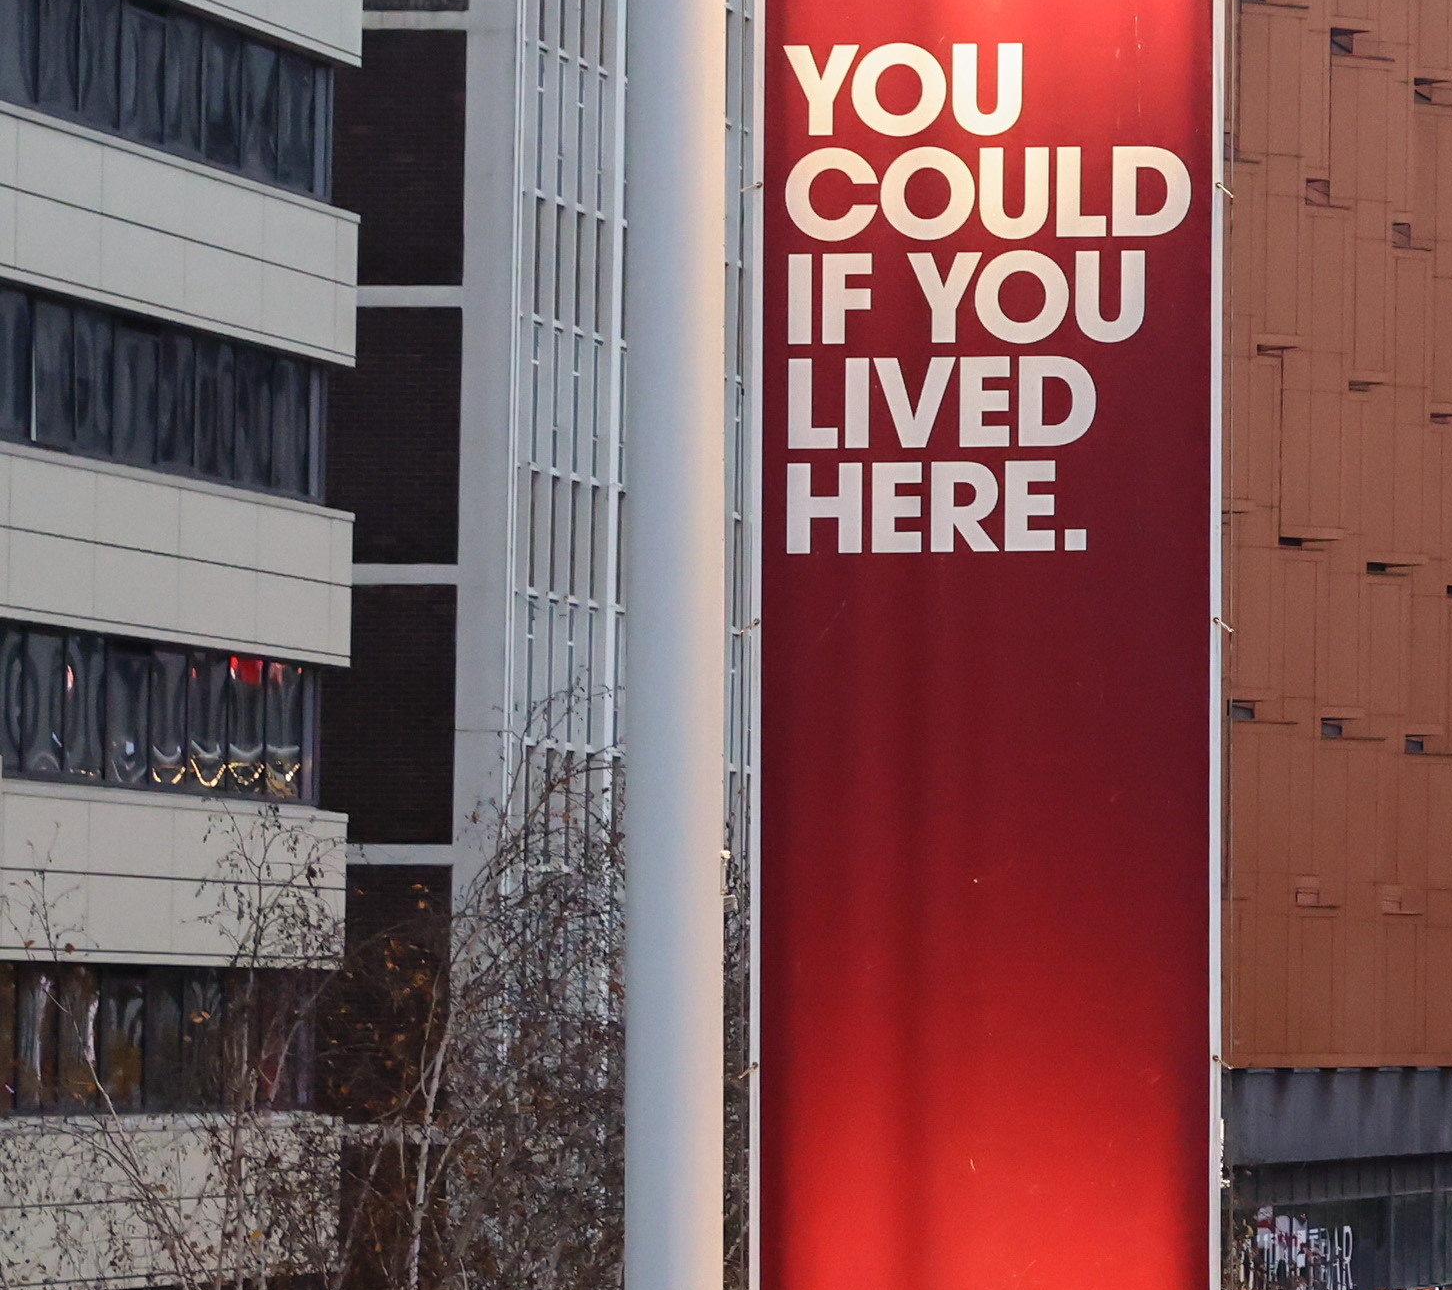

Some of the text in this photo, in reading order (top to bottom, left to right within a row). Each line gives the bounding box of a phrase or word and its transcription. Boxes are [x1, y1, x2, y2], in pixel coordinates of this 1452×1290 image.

[783, 43, 1023, 136] YOU
[785, 146, 1191, 241] COULD
[788, 250, 1146, 344] IF YOU
[788, 356, 1096, 449] LIVED
[787, 461, 1087, 553] HERE.
